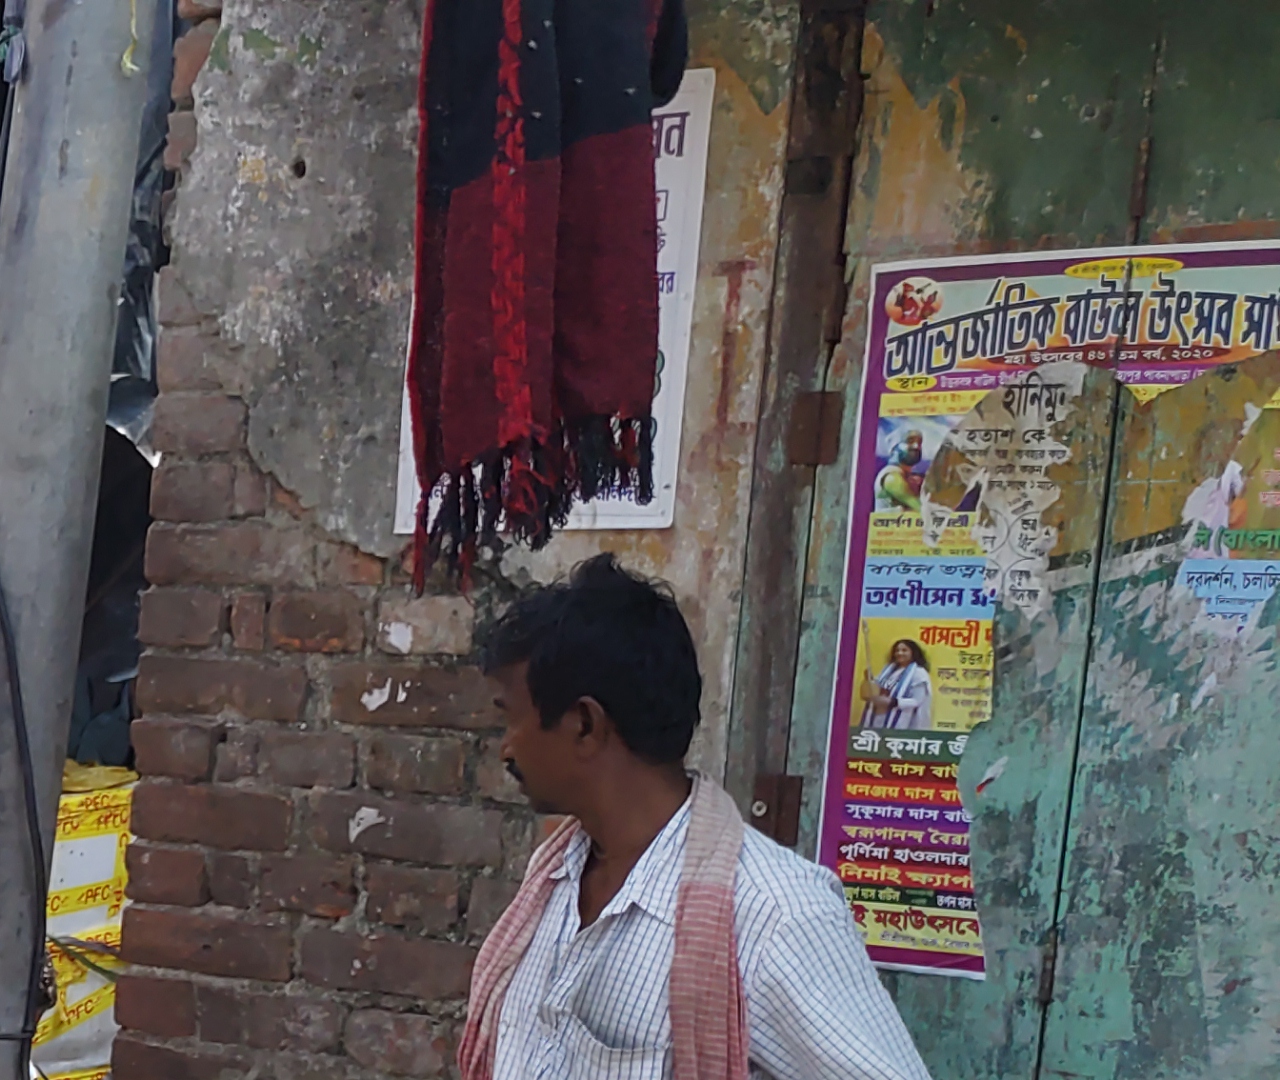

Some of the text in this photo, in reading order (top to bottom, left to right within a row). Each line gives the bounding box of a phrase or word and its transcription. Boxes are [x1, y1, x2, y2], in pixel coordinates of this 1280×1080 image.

[1148, 271, 1237, 346] উৎসব
[1171, 349, 1214, 361] ২০২০
[867, 562, 935, 577] বাউল
[851, 730, 881, 752] শ্রী
[884, 736, 943, 758] কুমার
[890, 763, 926, 777] দাস
[904, 787, 935, 800] দাস
[907, 807, 939, 821] দাস
[839, 842, 890, 861] পূর্ণিমা
